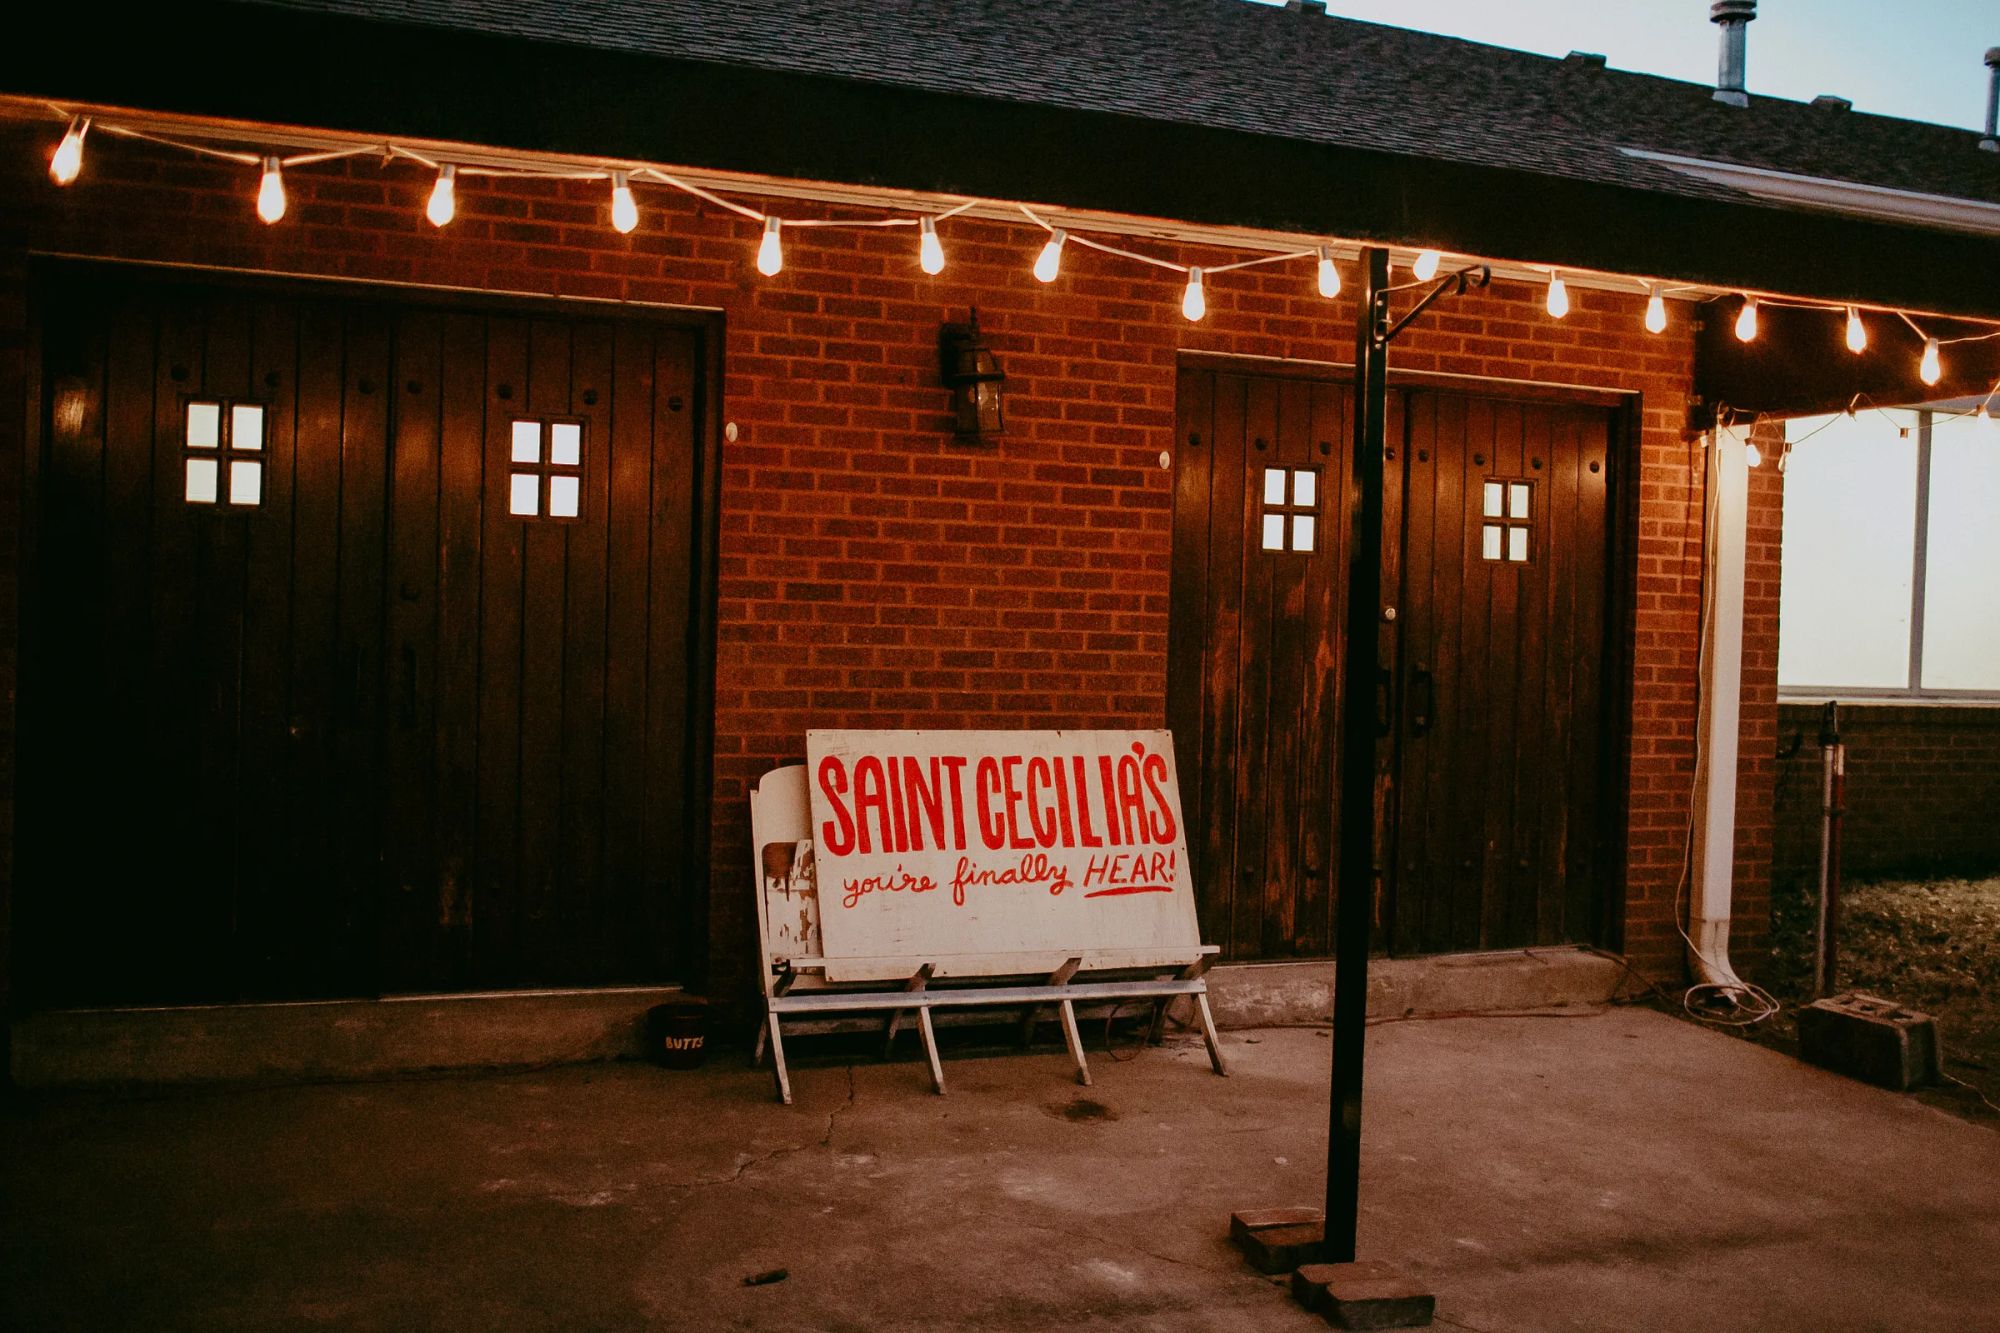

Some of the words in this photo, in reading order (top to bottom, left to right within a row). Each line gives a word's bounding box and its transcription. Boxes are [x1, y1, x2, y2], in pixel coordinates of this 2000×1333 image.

[817, 755, 968, 857] SAINT
[975, 740, 1177, 851] CECILIA'S
[842, 863, 938, 909] you're
[949, 853, 1074, 907] finally
[1083, 851, 1177, 887] HEAR!
[665, 1035, 705, 1050] BUTTS
